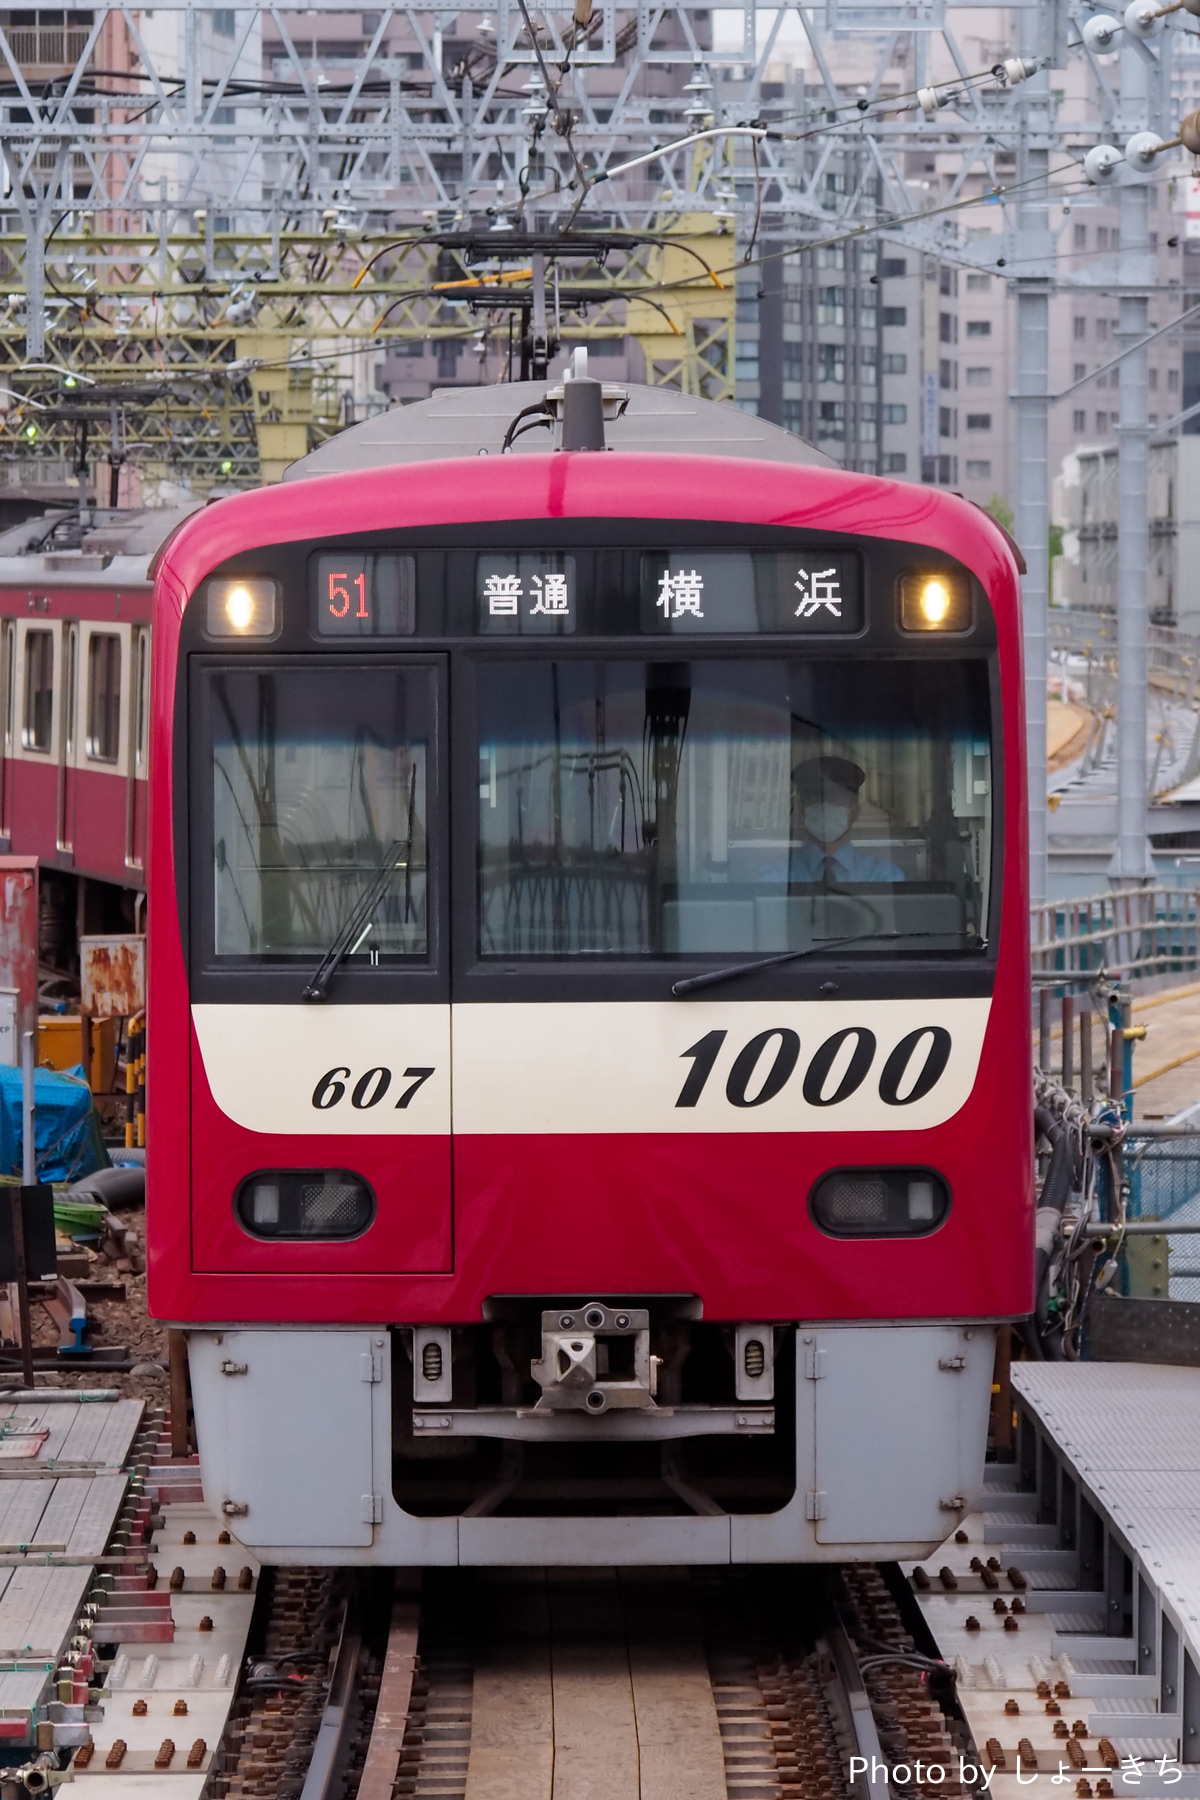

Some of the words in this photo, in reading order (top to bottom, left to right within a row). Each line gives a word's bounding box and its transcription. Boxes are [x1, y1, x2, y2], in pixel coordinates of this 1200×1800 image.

[328, 573, 369, 618] 51
[484, 574, 569, 615] 普通
[656, 569, 842, 618] 横浜
[312, 1067, 435, 1110] 607
[674, 1026, 953, 1108] 1000
